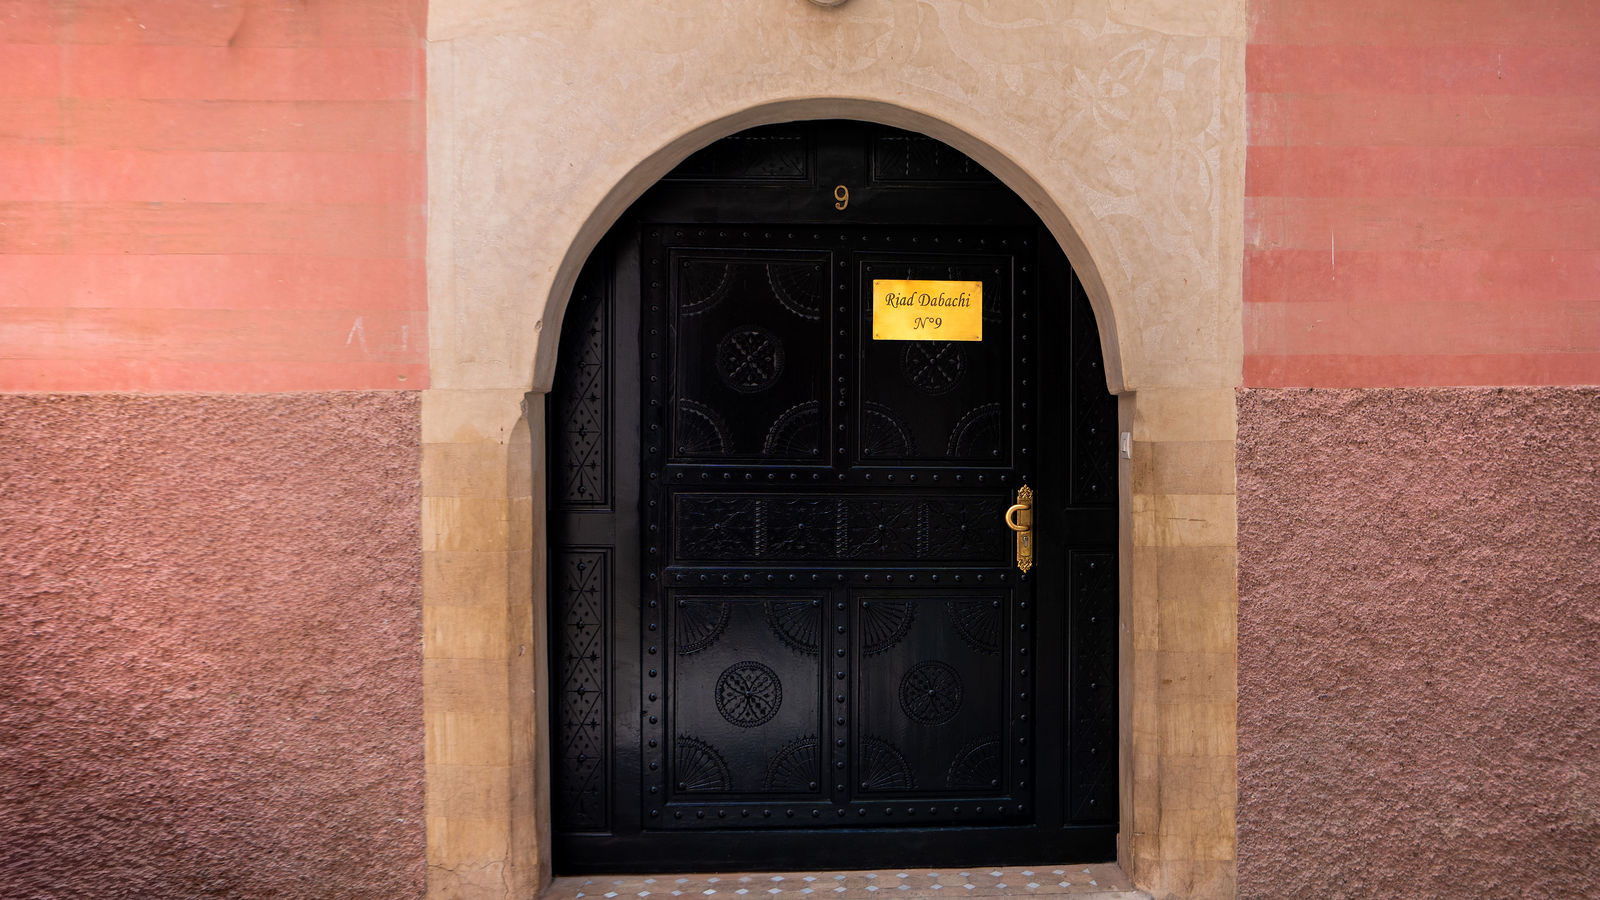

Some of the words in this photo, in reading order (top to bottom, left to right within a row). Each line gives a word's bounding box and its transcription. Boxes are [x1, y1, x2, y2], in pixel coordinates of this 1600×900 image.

[834, 185, 849, 210] 9
[885, 292, 917, 308] Riad
[918, 292, 971, 307] Dabachi
